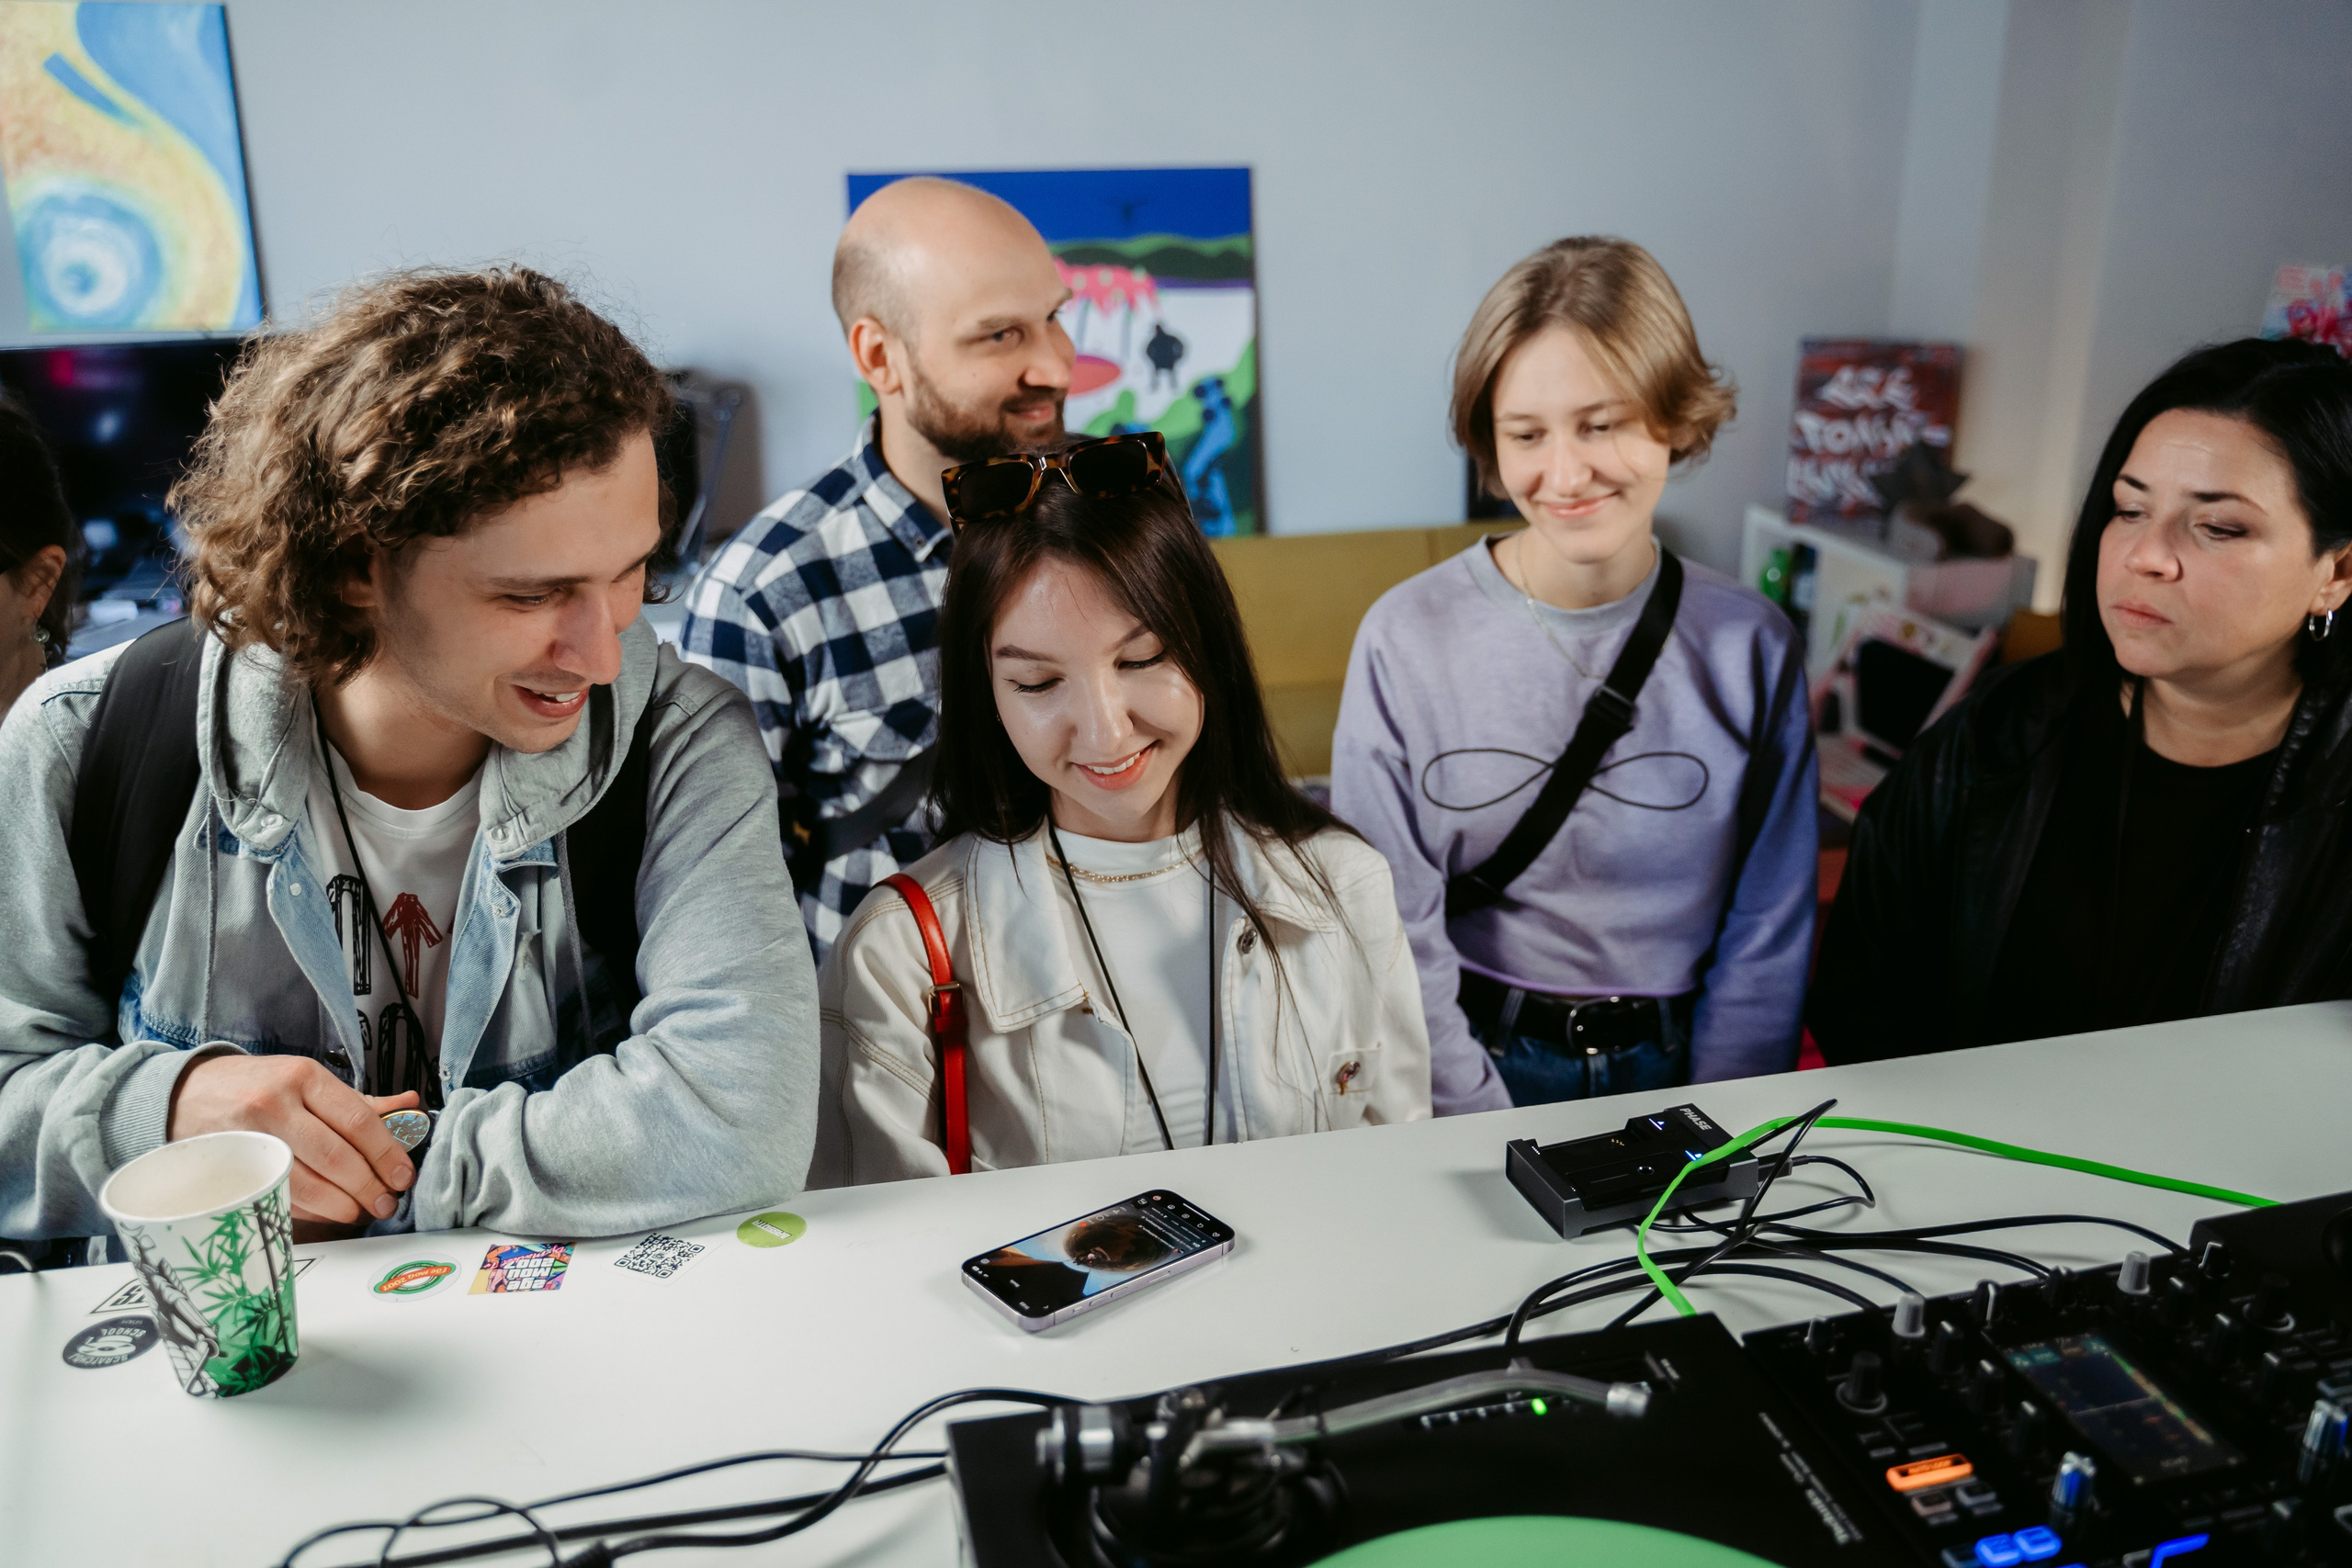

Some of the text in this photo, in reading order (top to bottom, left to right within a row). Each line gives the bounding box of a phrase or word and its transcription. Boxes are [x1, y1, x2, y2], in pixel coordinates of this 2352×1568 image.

[1679, 1108, 1713, 1131] PHASE
[503, 1257, 556, 1269] 2007
[382, 1277, 407, 1292] 2007
[100, 1326, 147, 1338] SCHOOL
